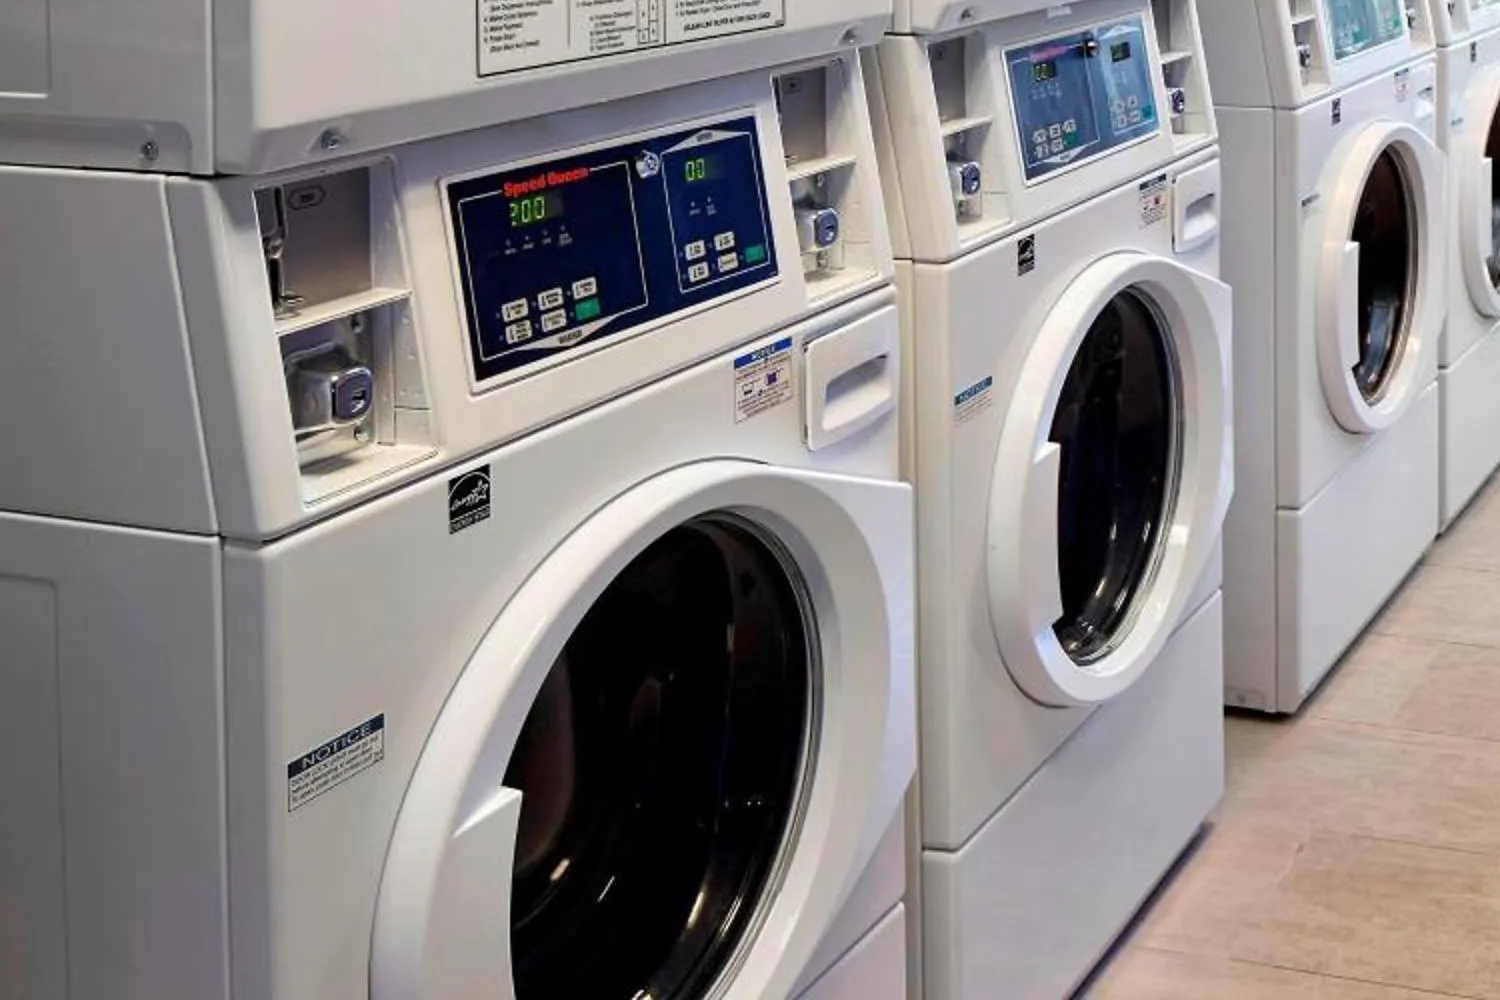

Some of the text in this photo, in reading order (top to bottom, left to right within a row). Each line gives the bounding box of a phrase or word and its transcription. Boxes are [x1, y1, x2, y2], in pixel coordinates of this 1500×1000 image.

[503, 167, 588, 197] Speed Queen
[301, 722, 370, 769] NOTICE
